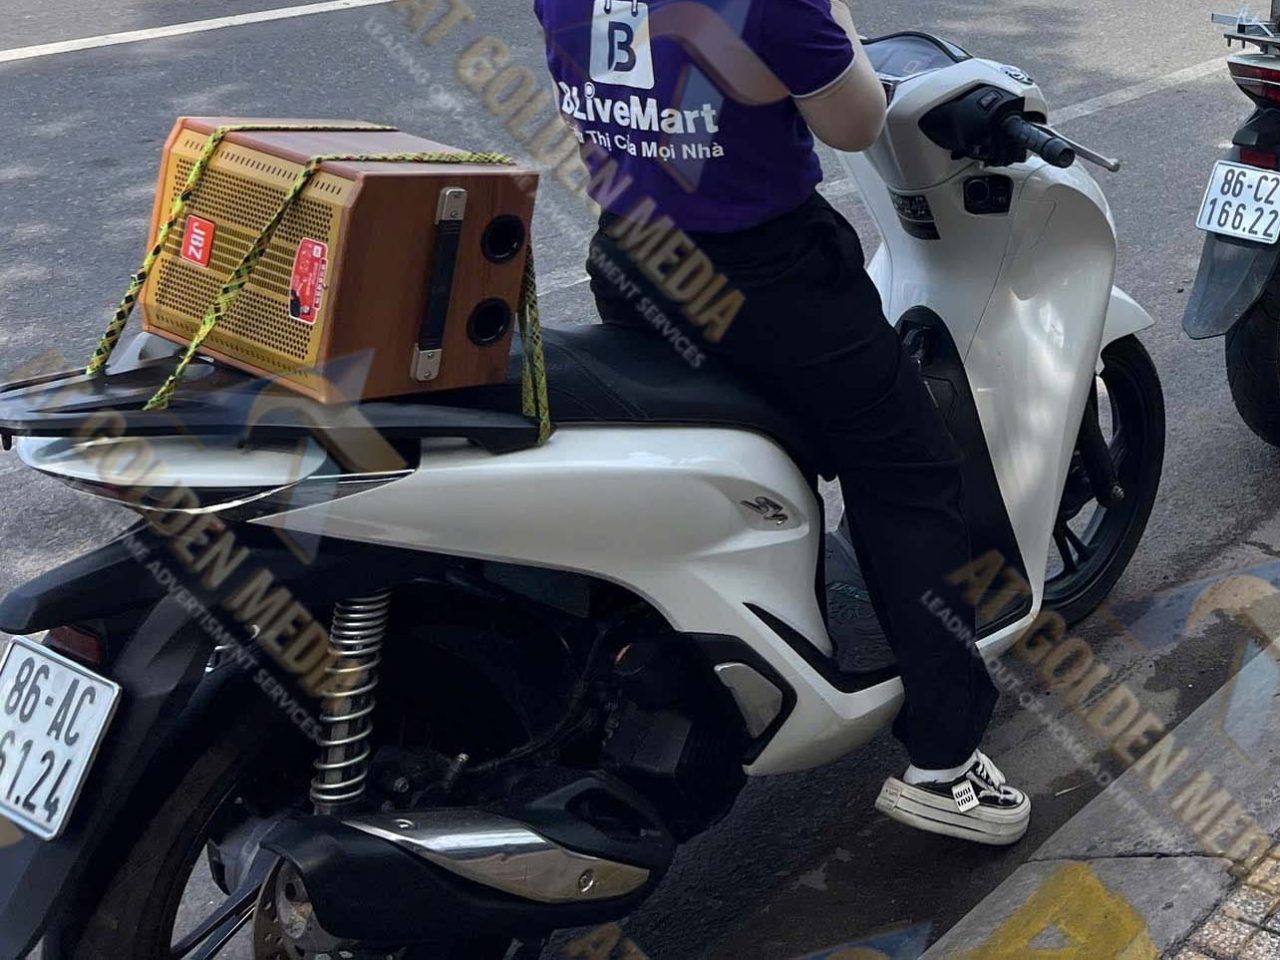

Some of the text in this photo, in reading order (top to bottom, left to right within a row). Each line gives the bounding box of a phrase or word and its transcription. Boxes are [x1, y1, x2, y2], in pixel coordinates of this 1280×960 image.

[608, 21, 636, 72] B
[561, 81, 719, 135] BLiveMart
[589, 129, 613, 151] Thị
[641, 142, 676, 162] Mọi
[682, 141, 725, 160] Nhà
[1220, 168, 1280, 205] 86-C2
[1206, 197, 1279, 238] 166.22
[4, 657, 97, 747] 86-AC
